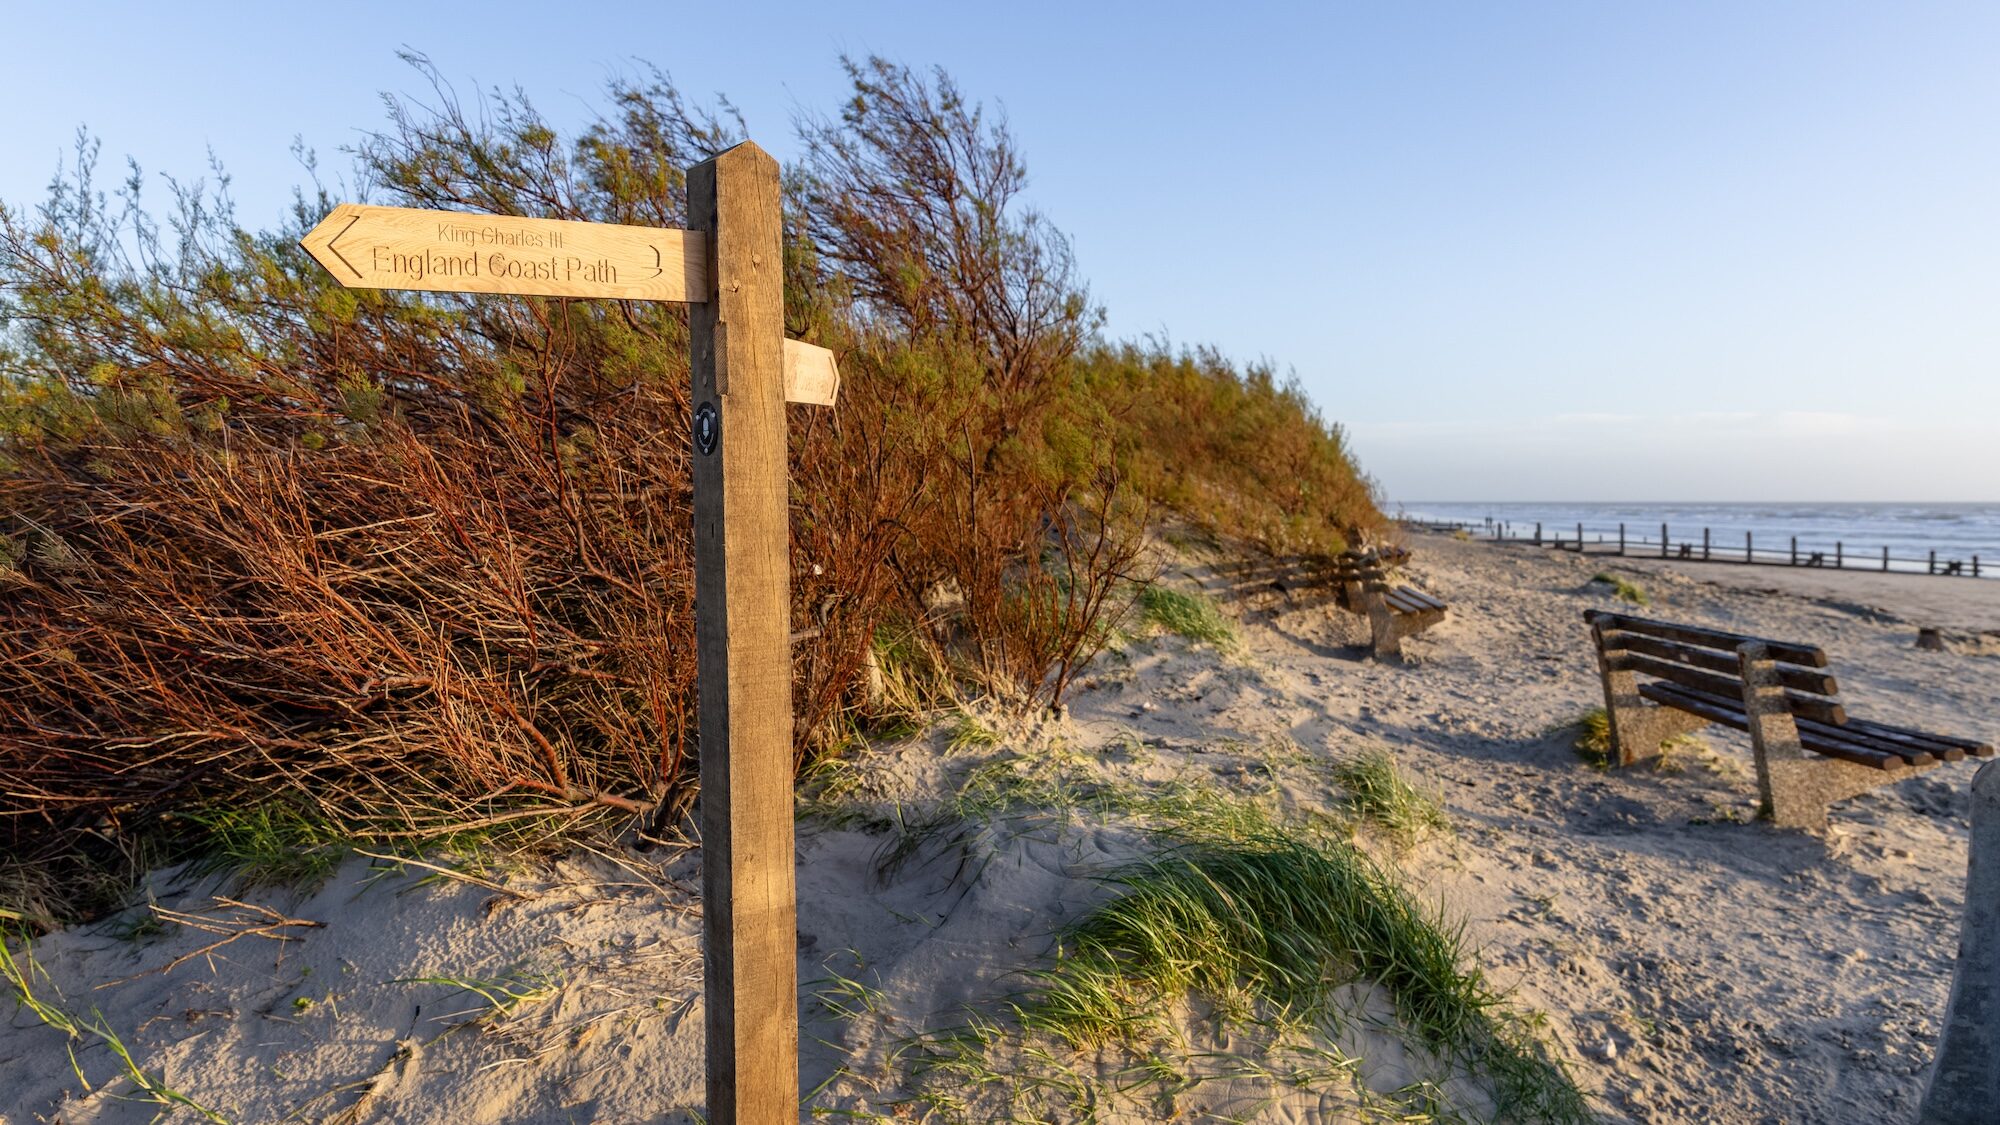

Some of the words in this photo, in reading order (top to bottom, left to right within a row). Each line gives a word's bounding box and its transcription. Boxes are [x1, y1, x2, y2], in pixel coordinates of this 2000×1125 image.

[437, 223, 476, 247] King
[480, 226, 543, 247] Charles
[549, 231, 563, 249] III
[372, 246, 478, 281] England
[488, 252, 558, 281] Coast
[566, 256, 617, 284] Path
